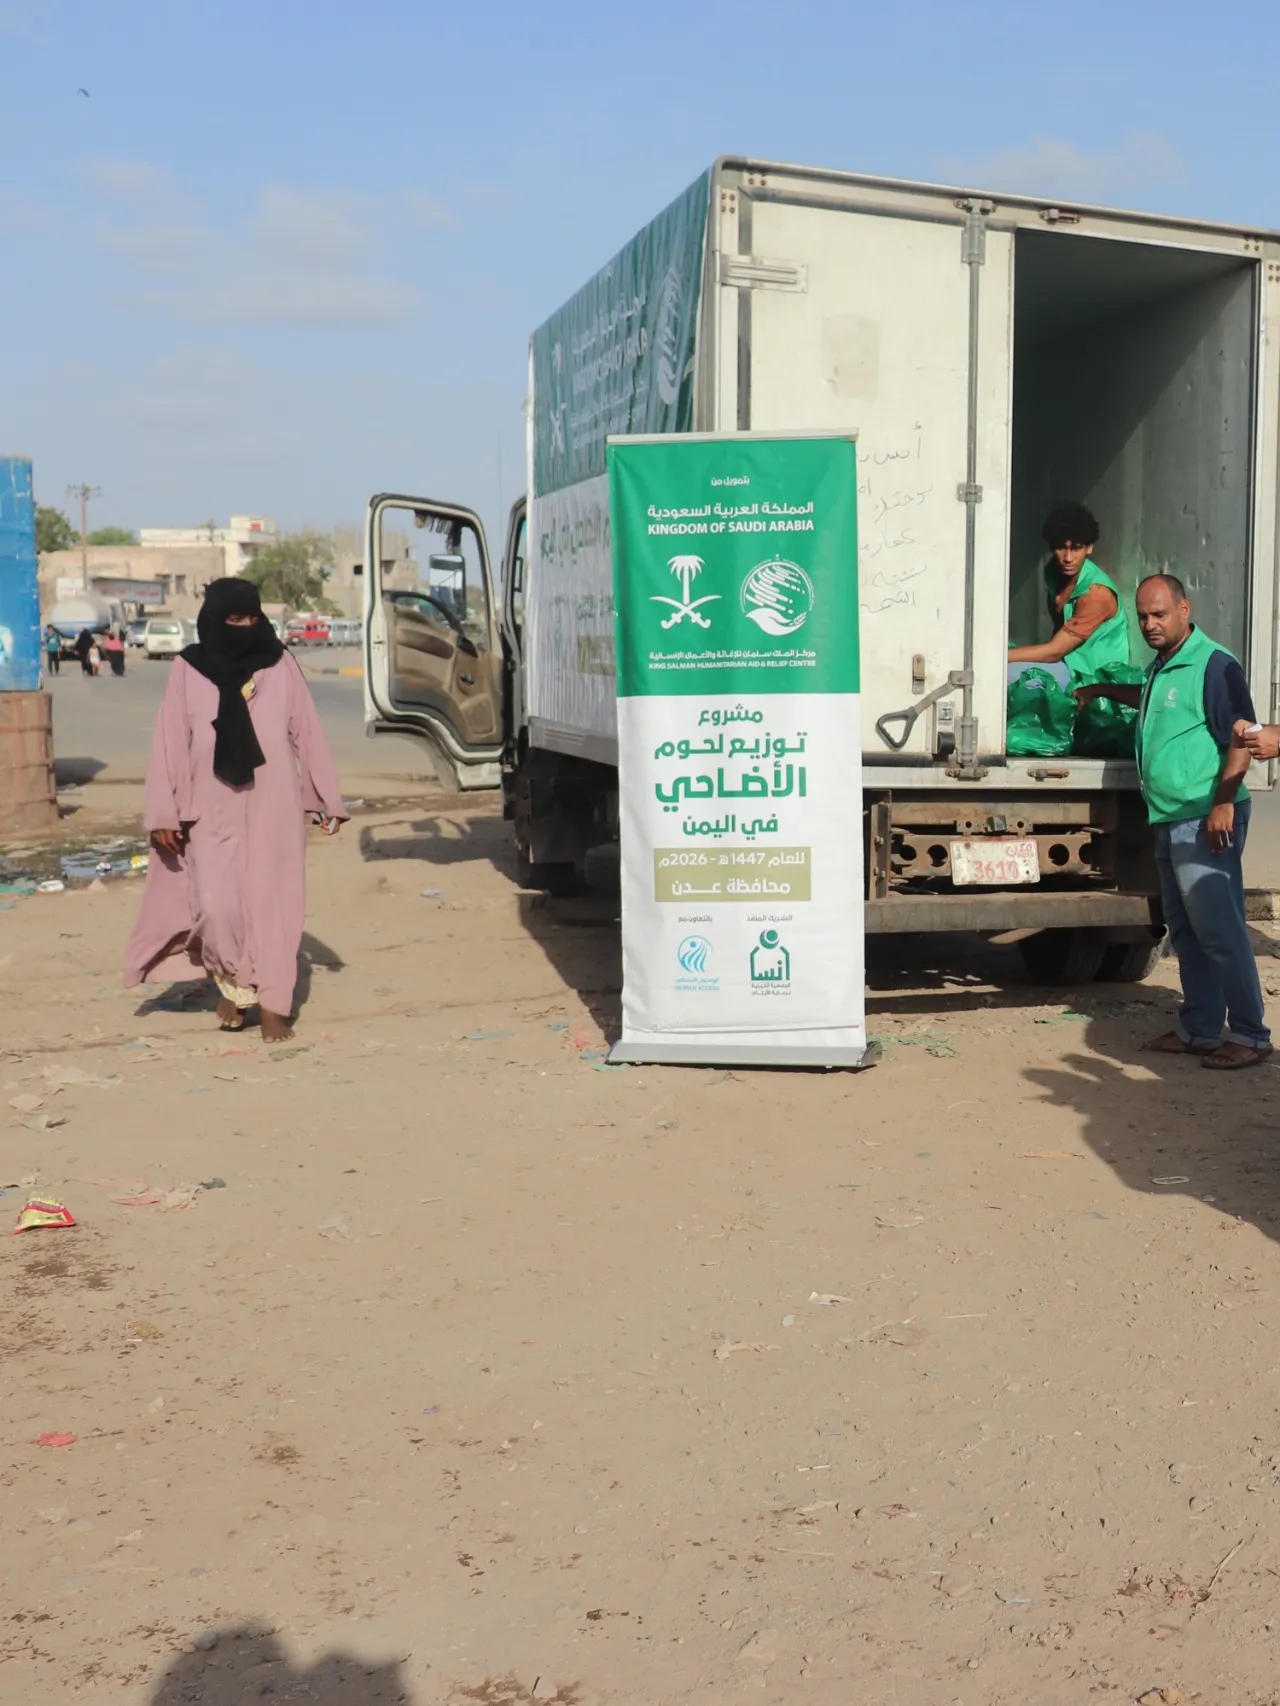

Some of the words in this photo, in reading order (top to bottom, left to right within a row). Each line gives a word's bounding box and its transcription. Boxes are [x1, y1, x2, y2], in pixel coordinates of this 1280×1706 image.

[711, 477, 723, 486] من
[724, 475, 750, 486] بتمويل
[647, 505, 711, 520] السعودية
[714, 503, 758, 518] العربية
[761, 501, 814, 515] المملكة
[648, 523, 708, 535] KINGDOM
[710, 522, 726, 533] OF
[729, 521, 766, 532] SAUDI
[769, 520, 814, 531] ARABIA
[697, 661, 747, 669] HUMANITARIAN
[698, 703, 763, 726] مشروع
[654, 733, 724, 760] لحوم
[728, 732, 808, 759] توزيع
[655, 760, 807, 812] الأضاحي
[683, 814, 736, 838] اليمن
[741, 813, 778, 840] في
[658, 852, 707, 868] 2026م
[768, 852, 805, 867] للعام
[672, 880, 722, 895] عدن
[726, 878, 791, 894] محافظة
